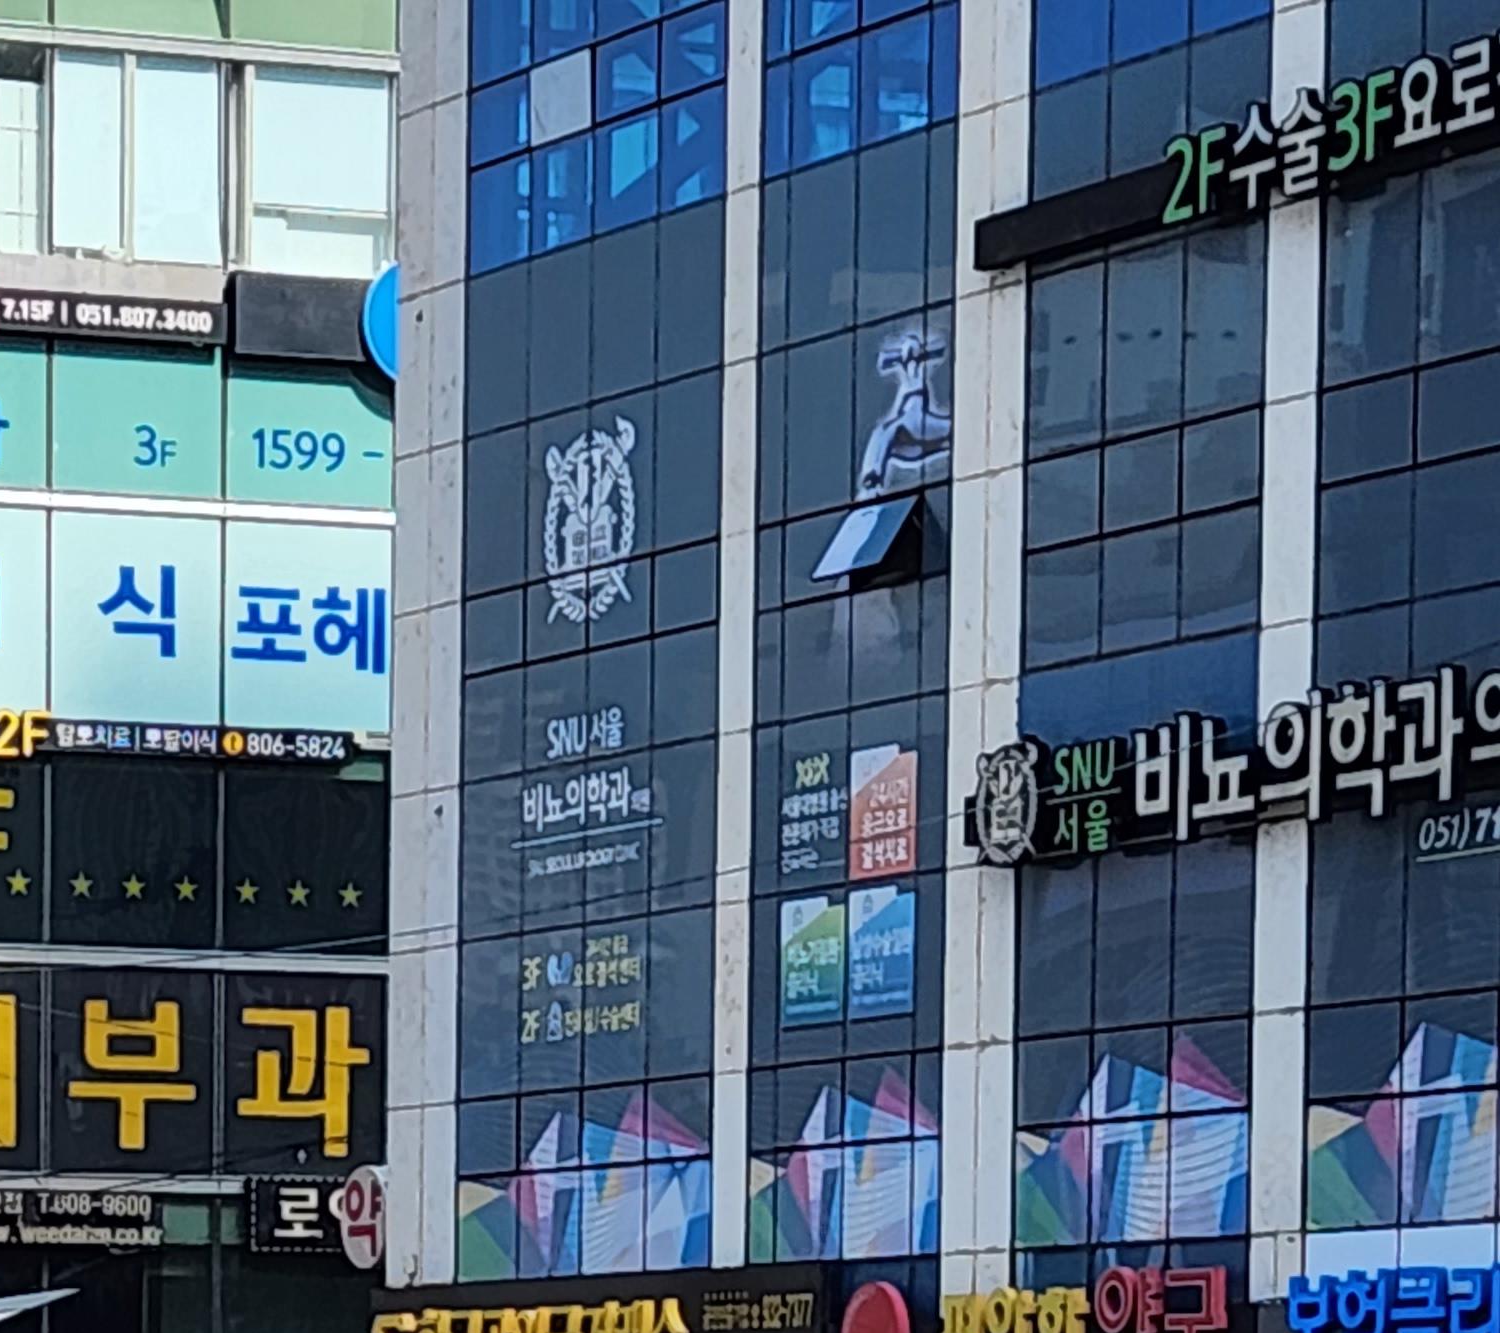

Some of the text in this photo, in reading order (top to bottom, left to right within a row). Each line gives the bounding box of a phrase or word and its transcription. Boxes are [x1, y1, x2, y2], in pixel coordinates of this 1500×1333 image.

[132, 424, 178, 467] 3F
[230, 584, 387, 676] 포헤
[246, 731, 346, 759] 806-5824
[546, 706, 625, 759] SNU 서울
[1054, 737, 1116, 797] SNU
[521, 766, 631, 832] 비뇨의학과
[1051, 799, 1112, 854] 서울
[345, 1178, 384, 1258] 약
